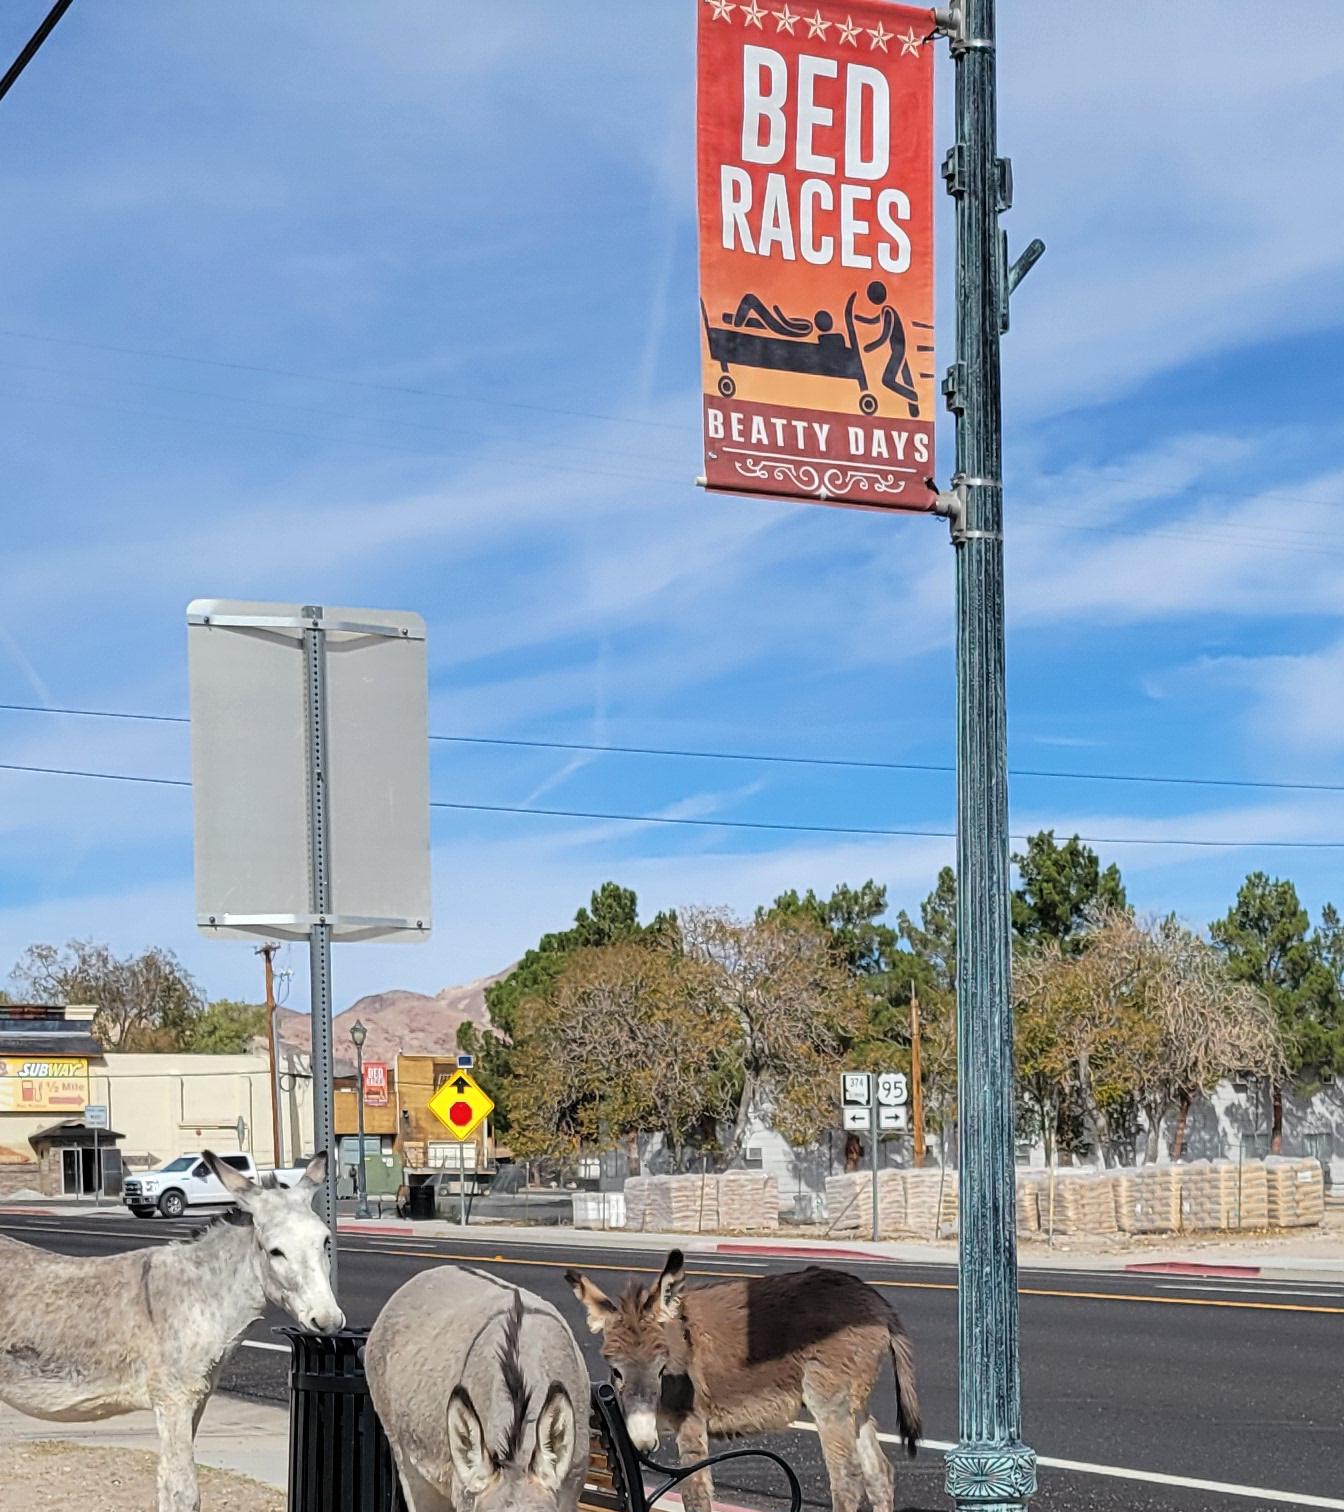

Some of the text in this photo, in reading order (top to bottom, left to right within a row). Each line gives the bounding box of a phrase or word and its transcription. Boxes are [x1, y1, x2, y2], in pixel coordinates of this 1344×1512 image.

[741, 44, 890, 181] BED
[720, 164, 912, 274] RACES
[707, 406, 930, 464] BEATTY DAYS
[18, 1063, 83, 1077] SUBWAY
[61, 1081, 85, 1092] Mile
[850, 1077, 864, 1088] 374
[882, 1081, 904, 1099] 95
